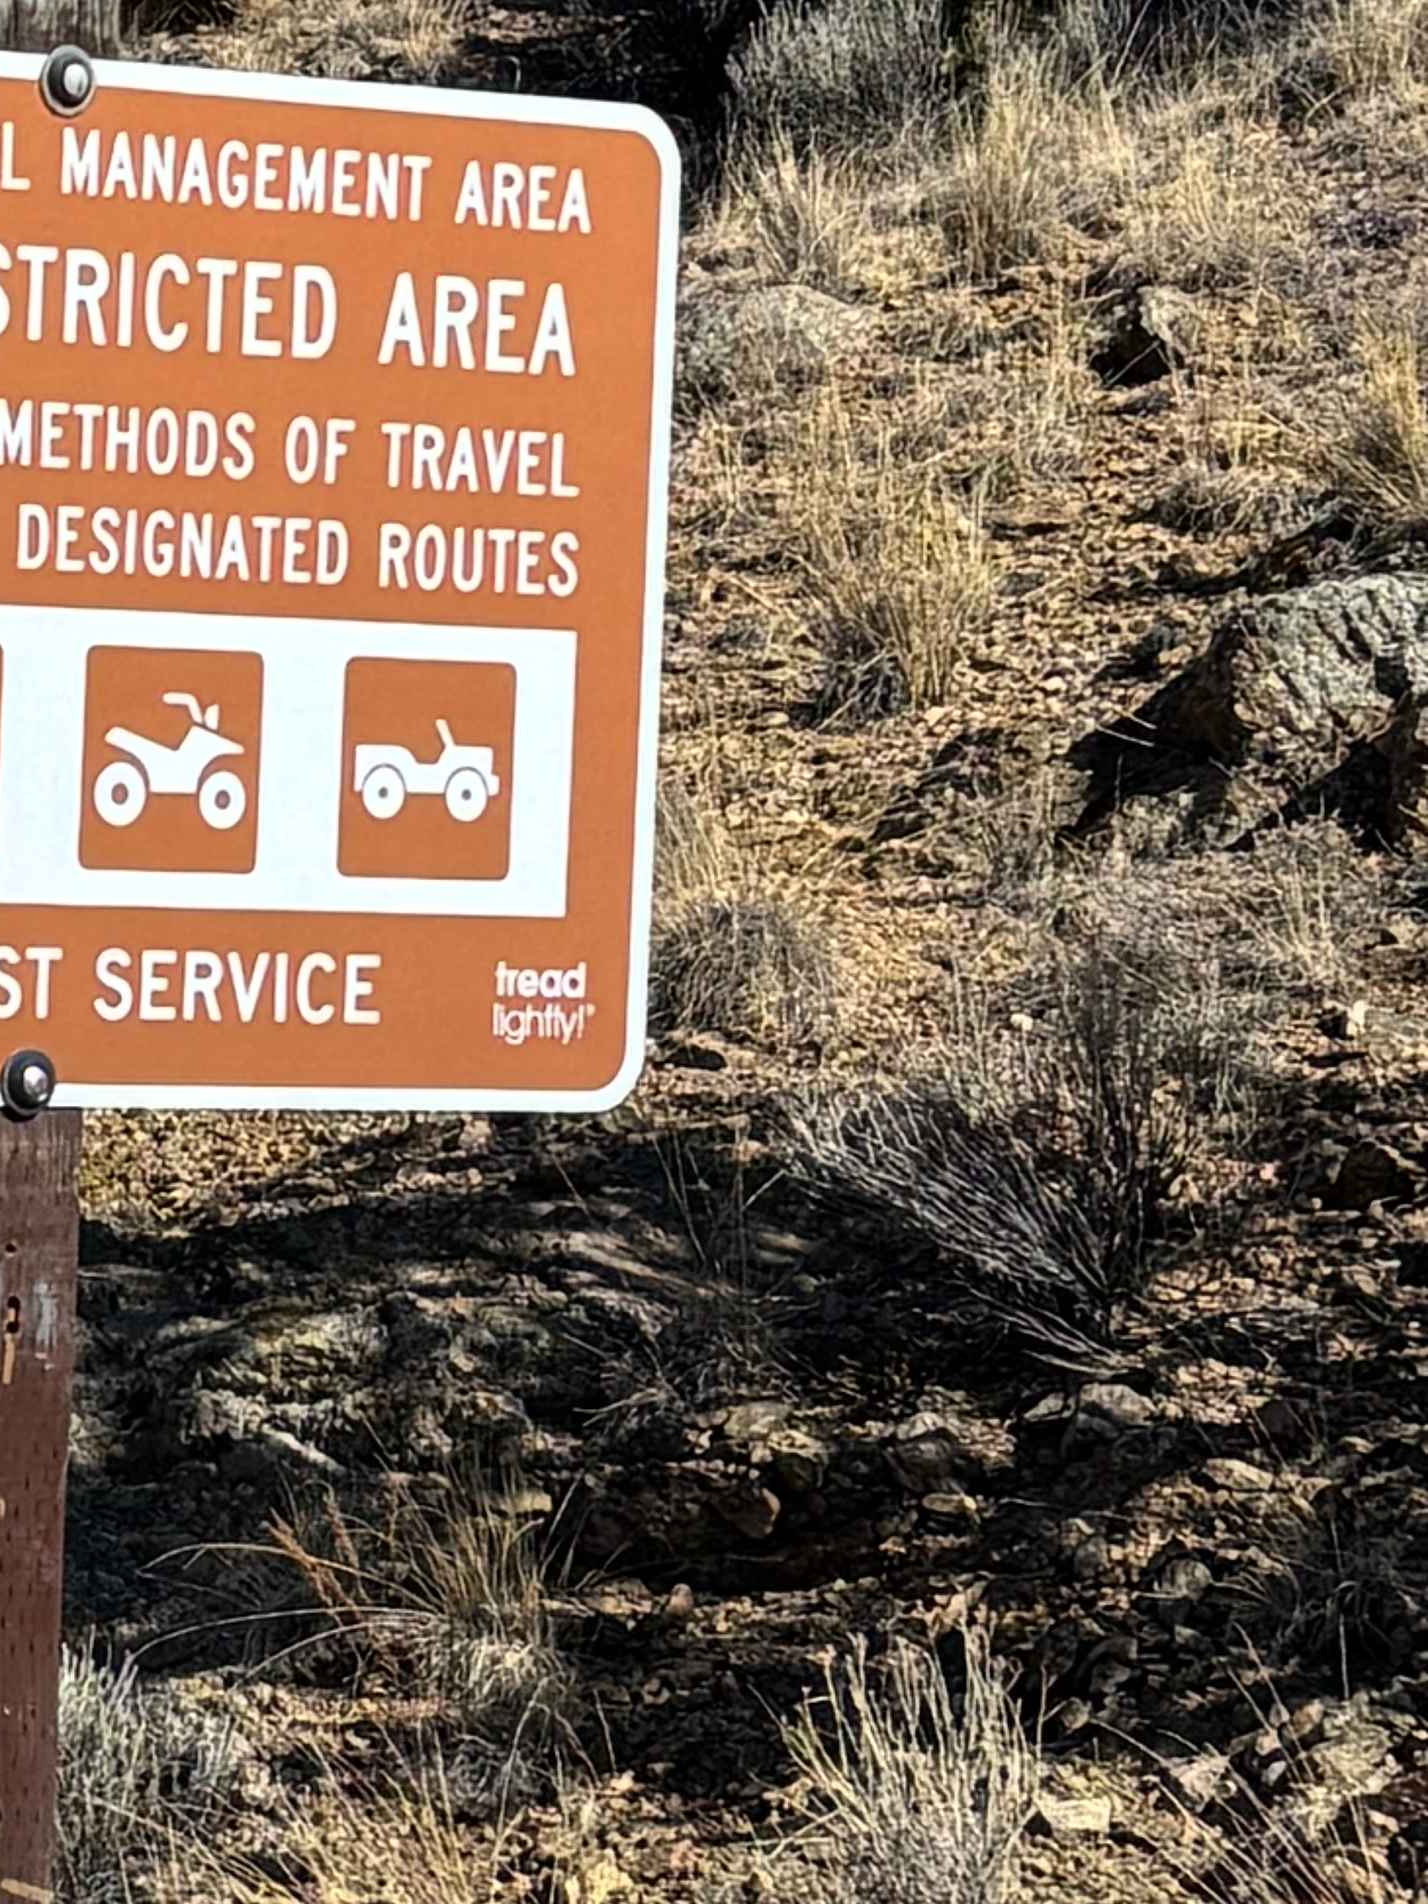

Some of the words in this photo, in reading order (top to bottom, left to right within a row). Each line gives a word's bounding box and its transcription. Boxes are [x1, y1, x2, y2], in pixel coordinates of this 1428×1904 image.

[61, 127, 432, 220] MANAGEMENT
[455, 160, 591, 233] AREA
[378, 272, 575, 376] AREA
[285, 416, 355, 484] OF
[382, 423, 579, 497] TRAVEL
[17, 502, 348, 584] DESIGNATED
[379, 525, 578, 596] ROUTES
[94, 948, 380, 1024] SERVICE
[494, 960, 587, 998] tread
